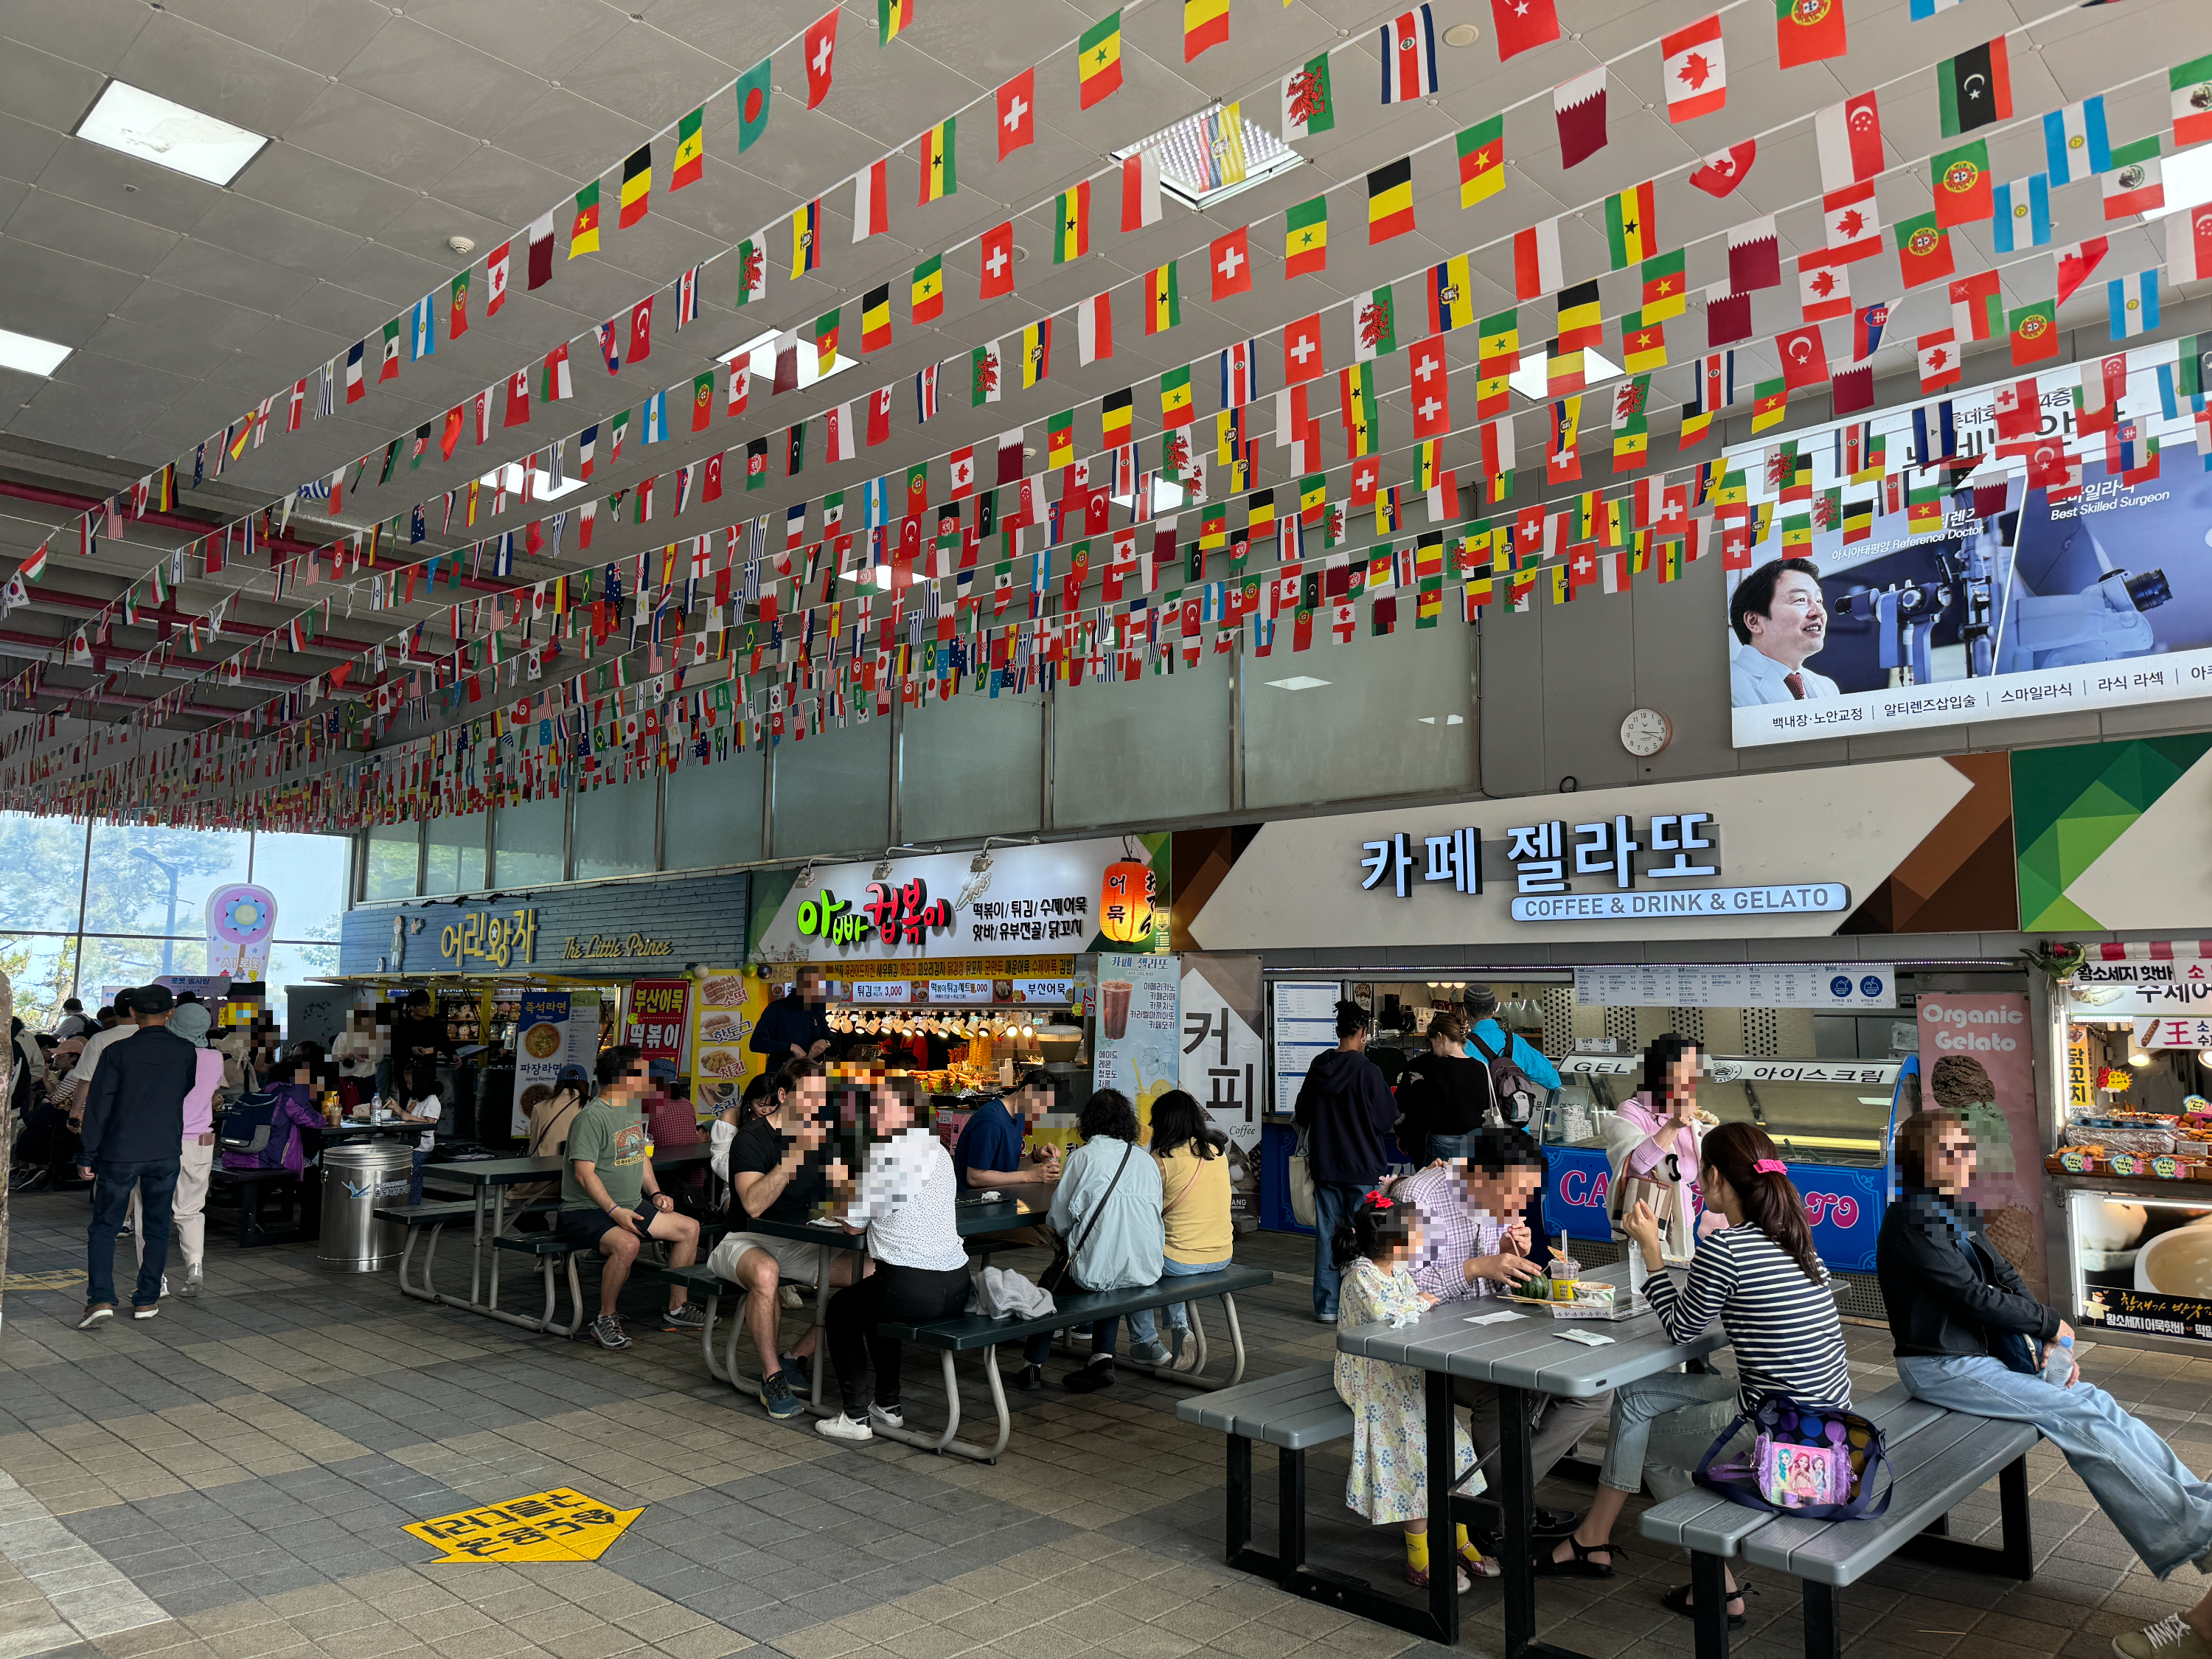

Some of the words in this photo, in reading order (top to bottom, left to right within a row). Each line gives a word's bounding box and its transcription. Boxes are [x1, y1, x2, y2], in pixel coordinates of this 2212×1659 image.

[2050, 507, 2078, 521] Best
[2079, 498, 2118, 515] Skilled
[2119, 490, 2170, 508] Surgeon
[1832, 541, 1891, 561] 아시아태평양
[1892, 533, 1945, 550] Reference
[1947, 524, 1984, 540] Doctor
[2098, 675, 2127, 692] 라식
[2133, 671, 2163, 687] 라섹
[2000, 682, 2073, 703] 스마일라식
[1884, 695, 1976, 717] 알티렌즈삽입술
[1773, 707, 1863, 729] 백내장·노안교정
[1360, 827, 1482, 897] 카페
[1506, 813, 1717, 893] 젤라또
[1040, 896, 1088, 917] 수제어묵
[1107, 874, 1127, 925] 어묵
[1525, 897, 1604, 917] COFFEE
[1610, 897, 1625, 914] &
[1632, 894, 1703, 914] DRINK
[1710, 894, 1725, 910] &
[1733, 887, 1830, 910] GELATO
[440, 908, 538, 967] 어린왕자
[1048, 919, 1084, 939] 닭꼬치
[563, 936, 583, 959] The
[585, 934, 625, 958] Little
[627, 932, 674, 957] Prince
[900, 961, 917, 977] 핫도그
[947, 960, 964, 976] 닭강정
[984, 959, 1004, 975] 군만두
[1005, 959, 1030, 975] 매운어묵
[1032, 959, 1057, 975] 수제어묵
[1060, 959, 1073, 975] 김밥
[1110, 956, 1133, 967] 카페
[1136, 957, 1169, 970] 젤라또
[2140, 965, 2173, 981] 핫바
[858, 985, 872, 998] 튀김
[885, 985, 902, 998] 3,000
[1028, 983, 1065, 995] 부산어묵
[1144, 982, 1175, 992] 아메리카노
[1150, 992, 1176, 1001] 카페라떼
[524, 1001, 567, 1015] 즉석라면
[633, 989, 684, 1014] 부산어묵
[723, 989, 749, 1008] 소떡
[1923, 1004, 2023, 1029] Organic
[630, 1023, 680, 1049] 떡볶이
[712, 1020, 754, 1044] 핫도그
[1935, 1031, 2017, 1051] Gelato
[2163, 1020, 2194, 1046] 王
[1099, 1050, 1119, 1059] 에이드
[1099, 1060, 1111, 1068] 레몬
[1183, 1007, 1253, 1122] 커피
[719, 1060, 747, 1081] 치킨
[1098, 1070, 1118, 1079] 청포도
[1753, 1068, 1885, 1084] 아이스크림
[2067, 1048, 2087, 1103] 닭꼬치
[1098, 1079, 1110, 1088] 자몽
[1229, 1125, 1256, 1137] Coffee
[2121, 1291, 2166, 1312] 참새가
[420, 1493, 587, 1539] 구름다리
[455, 1509, 616, 1557] 송도용궁
